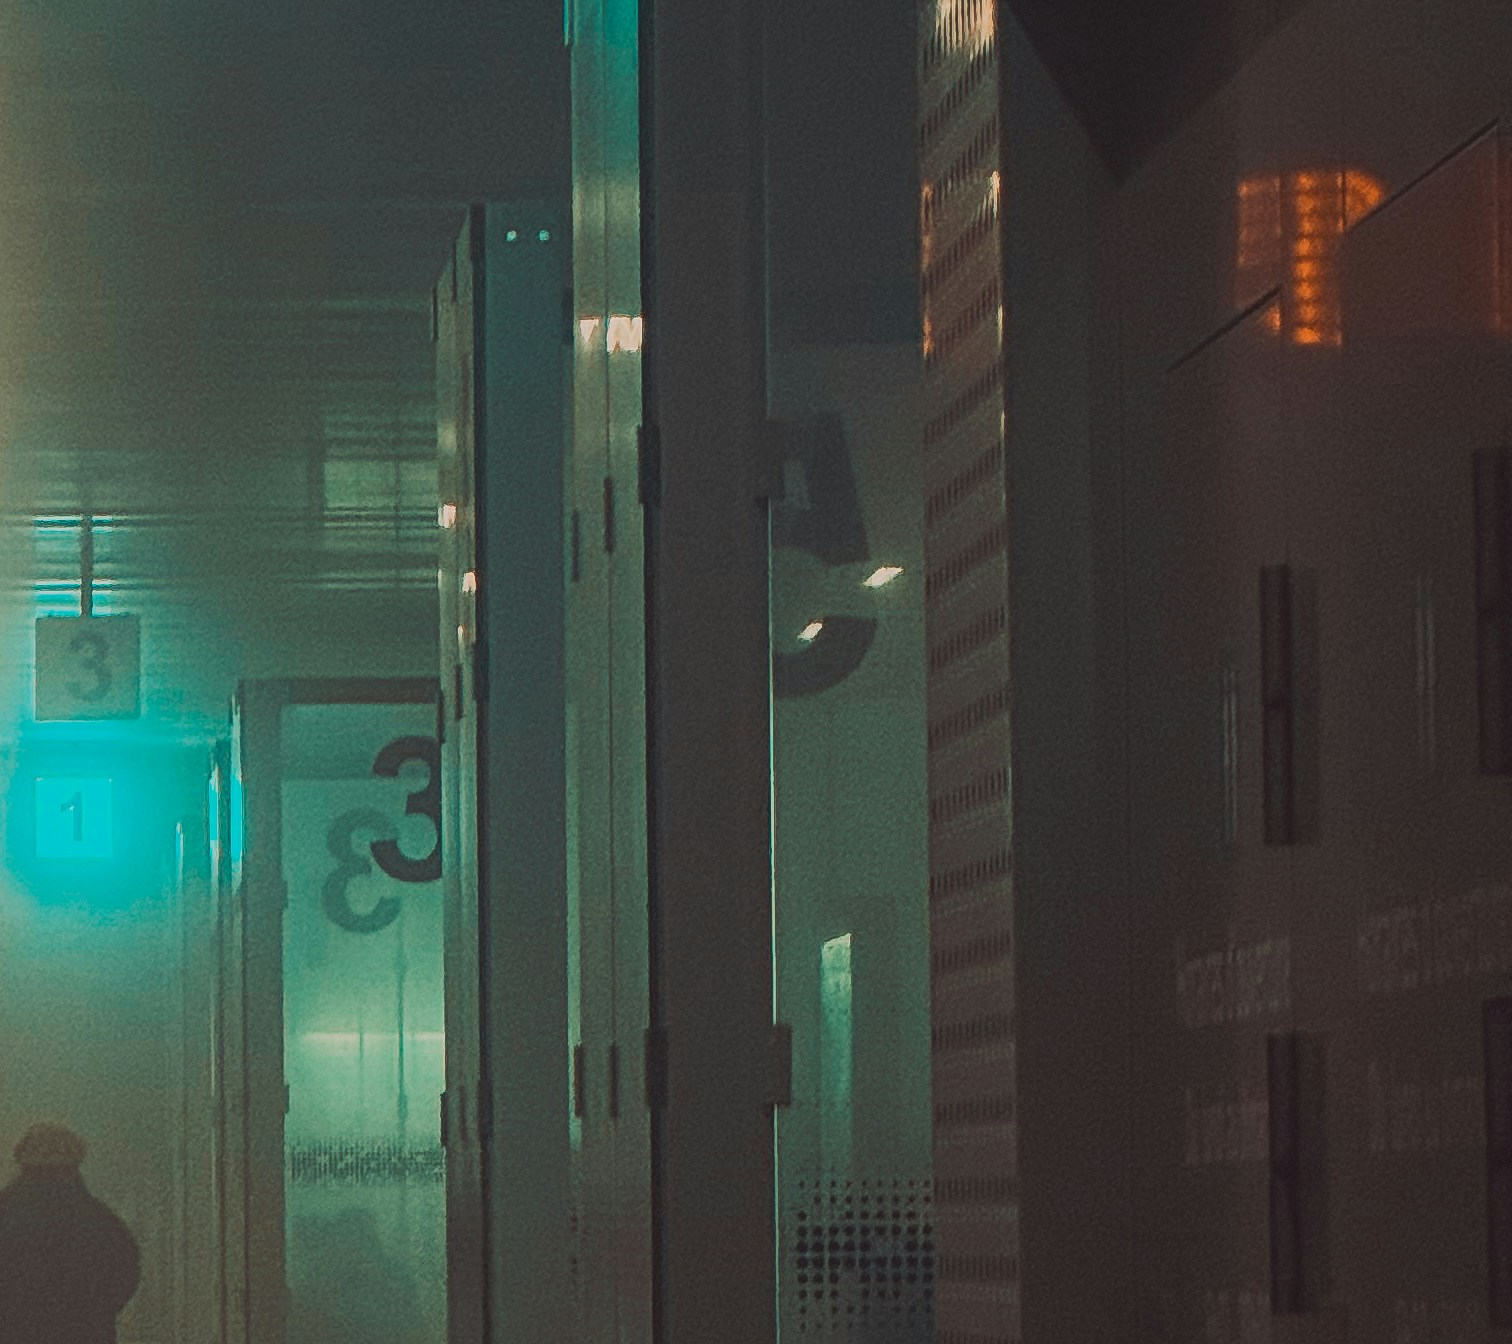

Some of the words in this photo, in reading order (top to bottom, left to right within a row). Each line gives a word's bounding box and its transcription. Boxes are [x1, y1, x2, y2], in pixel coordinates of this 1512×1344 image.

[66, 632, 114, 702] 3
[59, 790, 84, 843] 1
[371, 735, 443, 883] 3
